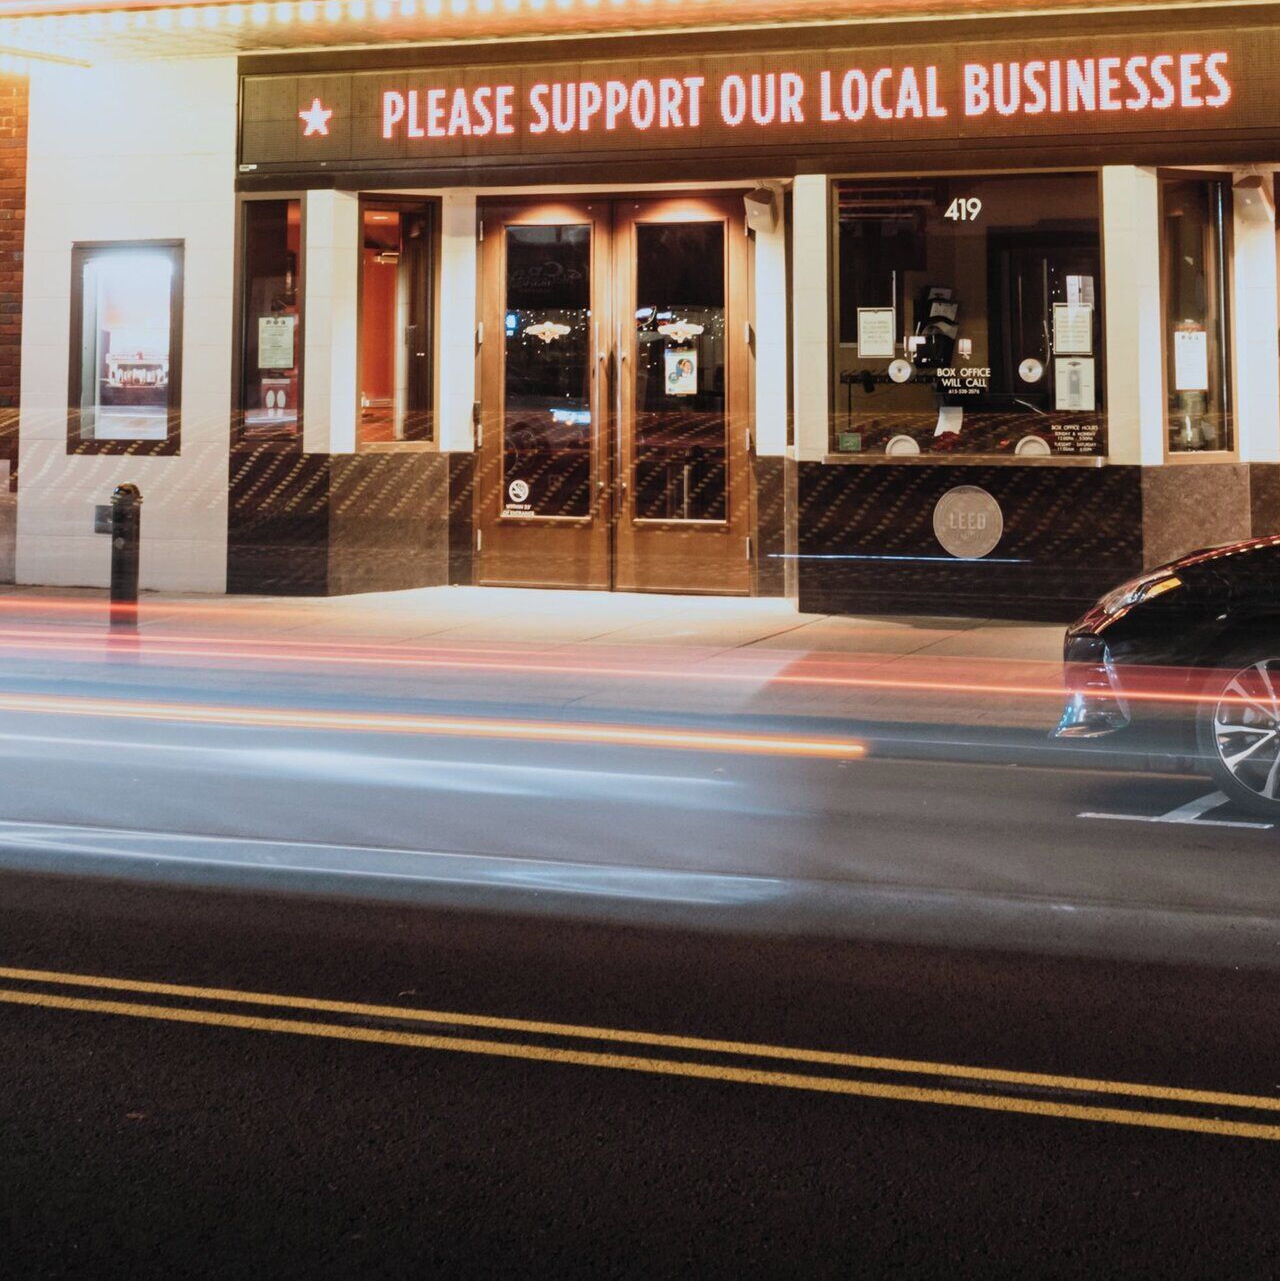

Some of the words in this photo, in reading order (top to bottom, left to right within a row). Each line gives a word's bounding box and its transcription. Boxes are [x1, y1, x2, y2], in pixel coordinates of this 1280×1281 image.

[381, 84, 516, 139] PLEASE
[529, 76, 706, 135] SUPPORT
[720, 71, 806, 126] OUR
[820, 65, 948, 122] LOCAL
[964, 51, 1232, 117] BUSINESSES
[943, 197, 982, 221] 419
[936, 367, 957, 377] BOX
[960, 367, 991, 377] OFFICE
[941, 378, 962, 387] WILL
[965, 378, 988, 387] CALL
[950, 512, 986, 529] LEED
